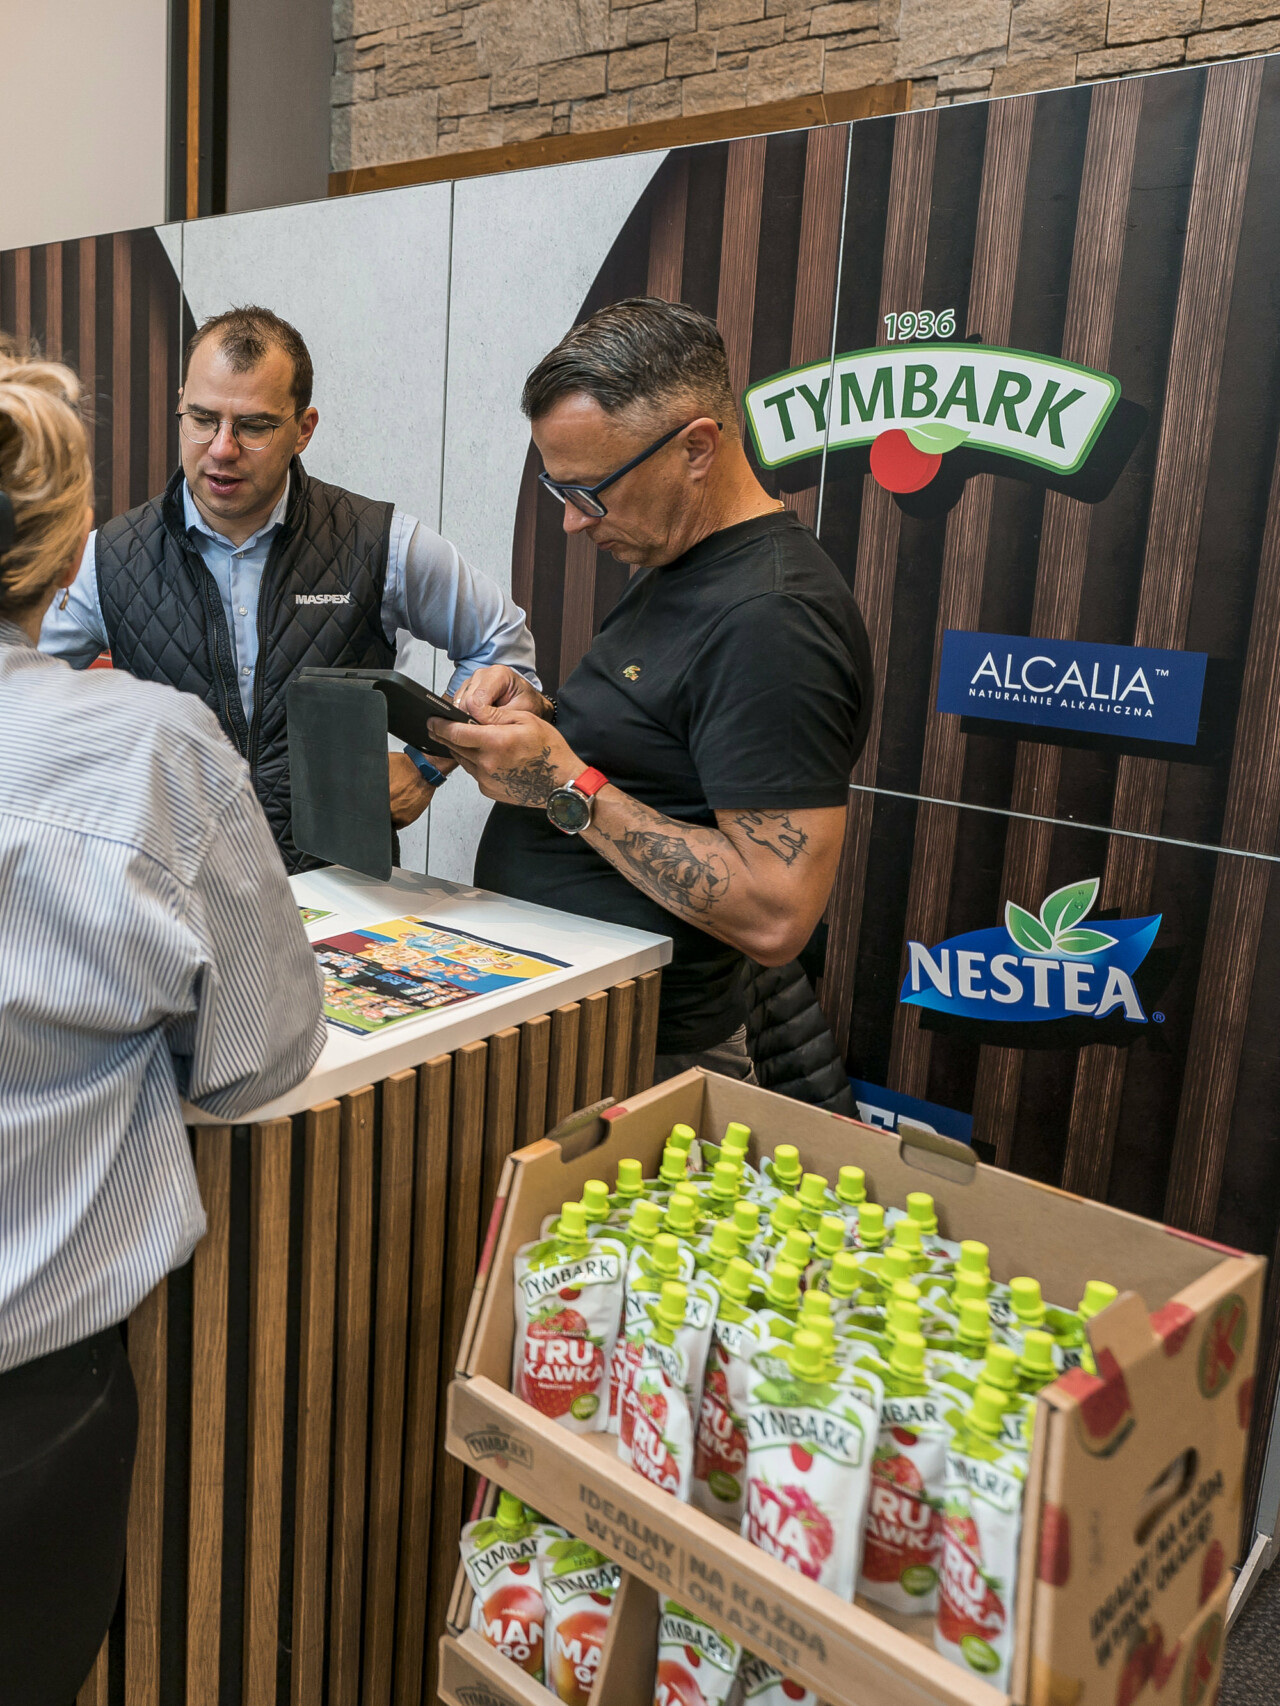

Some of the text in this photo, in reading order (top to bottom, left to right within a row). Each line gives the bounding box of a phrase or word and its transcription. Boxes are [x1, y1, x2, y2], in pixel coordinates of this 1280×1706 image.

[884, 309, 956, 340] 1936
[763, 363, 1086, 449] TYMBARK
[295, 592, 351, 605] MASPEX
[970, 651, 1155, 705] ALCALIA
[968, 688, 1154, 718] NATURALNIE ALKALICZNA
[908, 940, 1146, 1022] NESTEA
[525, 1337, 594, 1366] TRU
[523, 1363, 605, 1383] KAWKA
[702, 1397, 733, 1441] RU
[634, 1418, 667, 1466] RU
[579, 1483, 676, 1558] IDEALNY
[872, 1486, 932, 1529] RU
[584, 1511, 675, 1588] WYBÓR
[867, 1514, 944, 1551] AWKA
[551, 1565, 622, 1594] TYMBAR
[689, 1554, 725, 1594] NA
[944, 1545, 987, 1601] RU
[555, 1633, 603, 1668] MA
